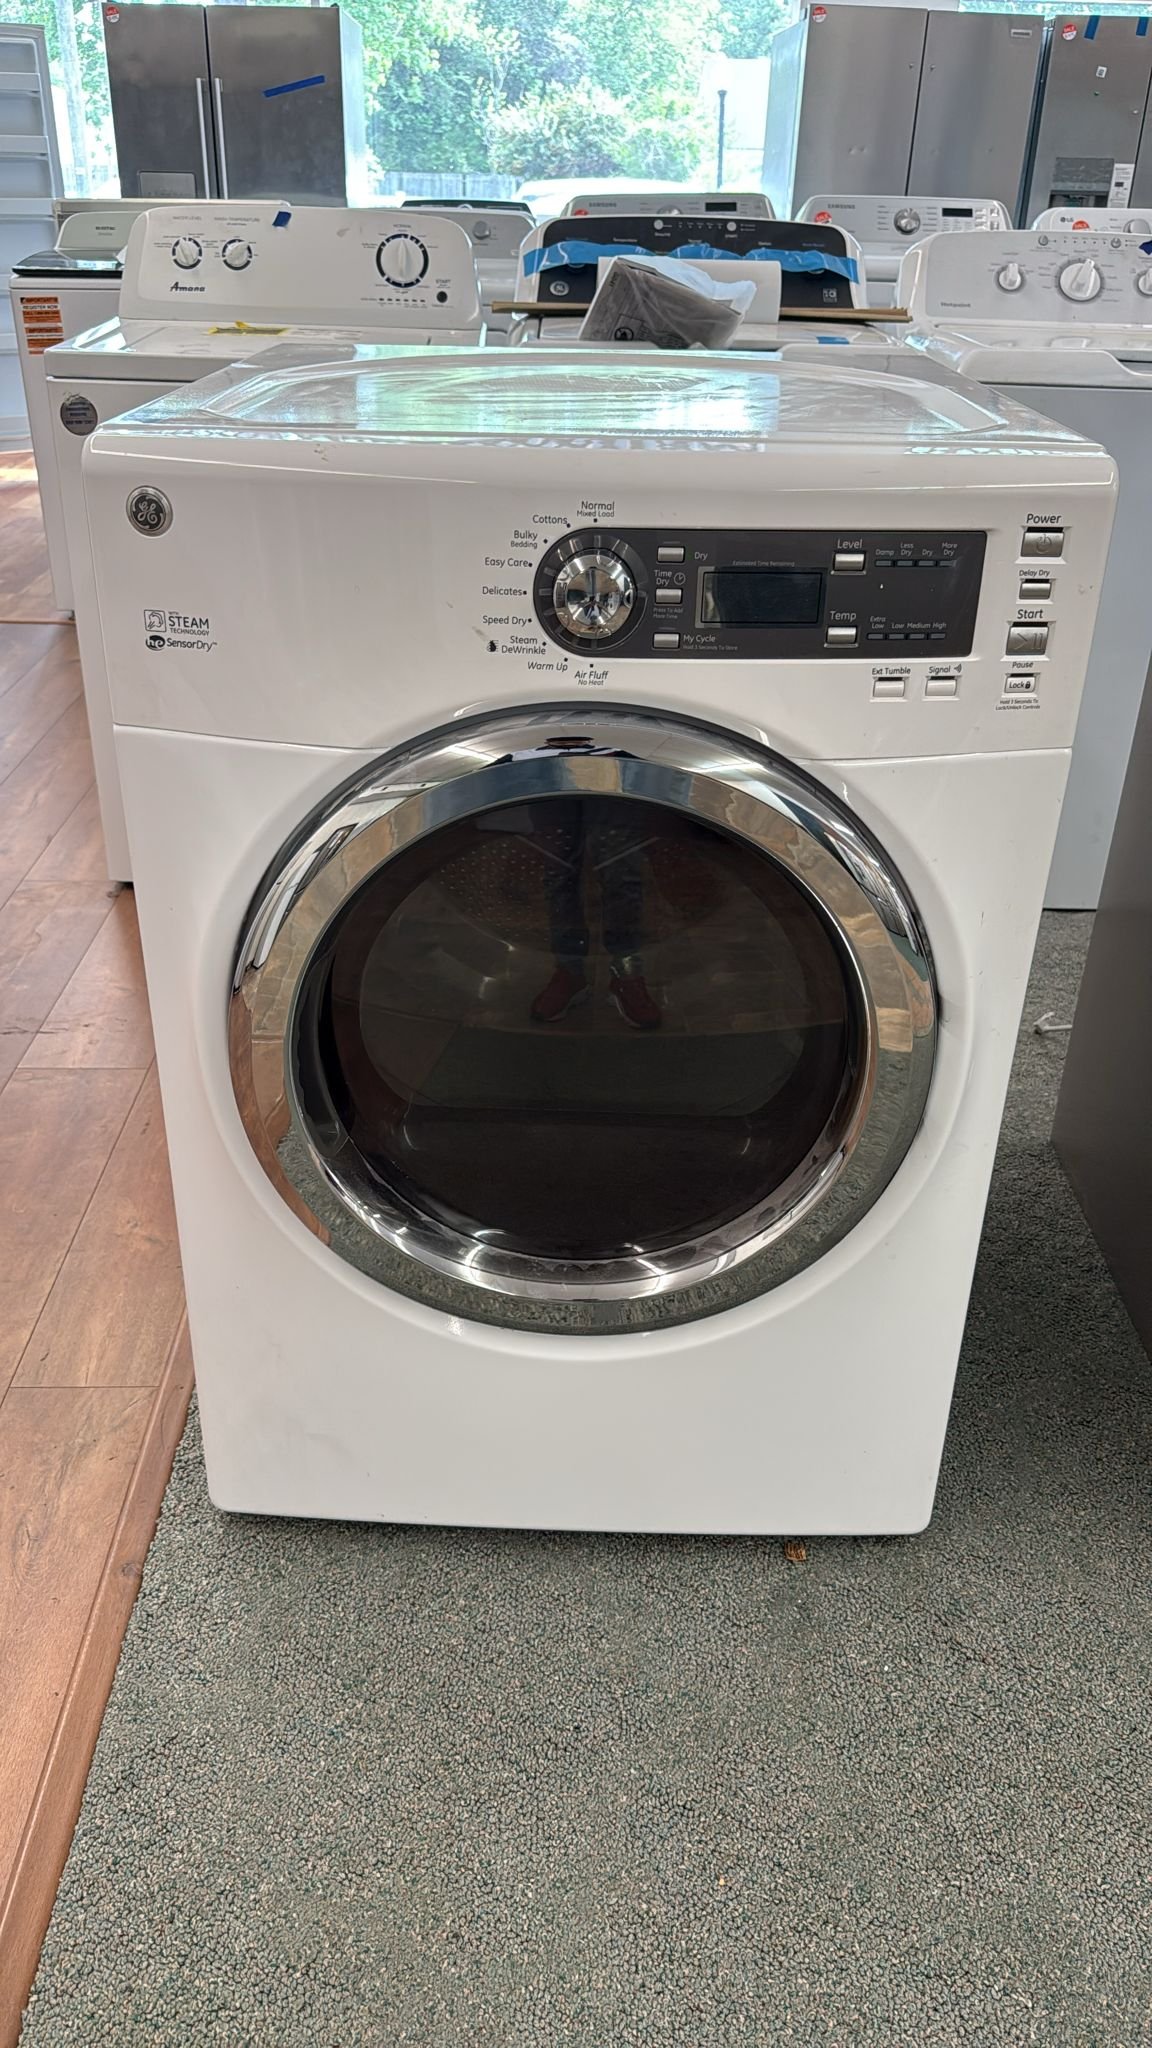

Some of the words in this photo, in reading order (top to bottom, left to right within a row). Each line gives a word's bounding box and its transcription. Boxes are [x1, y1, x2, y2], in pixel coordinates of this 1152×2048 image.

[170, 281, 205, 292] Amana
[581, 501, 615, 511] Normal
[532, 514, 568, 525] Cottons
[1026, 513, 1062, 524] Power
[513, 530, 538, 540] Bulky
[510, 540, 538, 550] Bedding
[837, 539, 863, 549] Level
[694, 552, 708, 560] Dry
[900, 549, 912, 557] Dry
[922, 549, 933, 557] Dry
[943, 549, 955, 557] Dry
[484, 557, 505, 568] Easy
[507, 558, 529, 567] Care
[656, 578, 669, 586] Dry
[482, 586, 523, 595] Delicates
[829, 611, 857, 621] Temp
[1017, 609, 1044, 619] Start
[168, 616, 209, 629] STEAM
[482, 615, 509, 625] Speed
[511, 616, 527, 627] Dry
[932, 622, 947, 630] High
[170, 627, 209, 636] TECHNOLOGY
[510, 636, 538, 644] Steam
[683, 635, 694, 643] My
[695, 635, 716, 643] Cycle
[501, 646, 546, 655] DeWrinkle
[527, 662, 553, 671] Warm
[556, 662, 568, 672] Up
[929, 665, 951, 674] Signal
[574, 671, 587, 679] Air
[588, 671, 609, 679] Fluff
